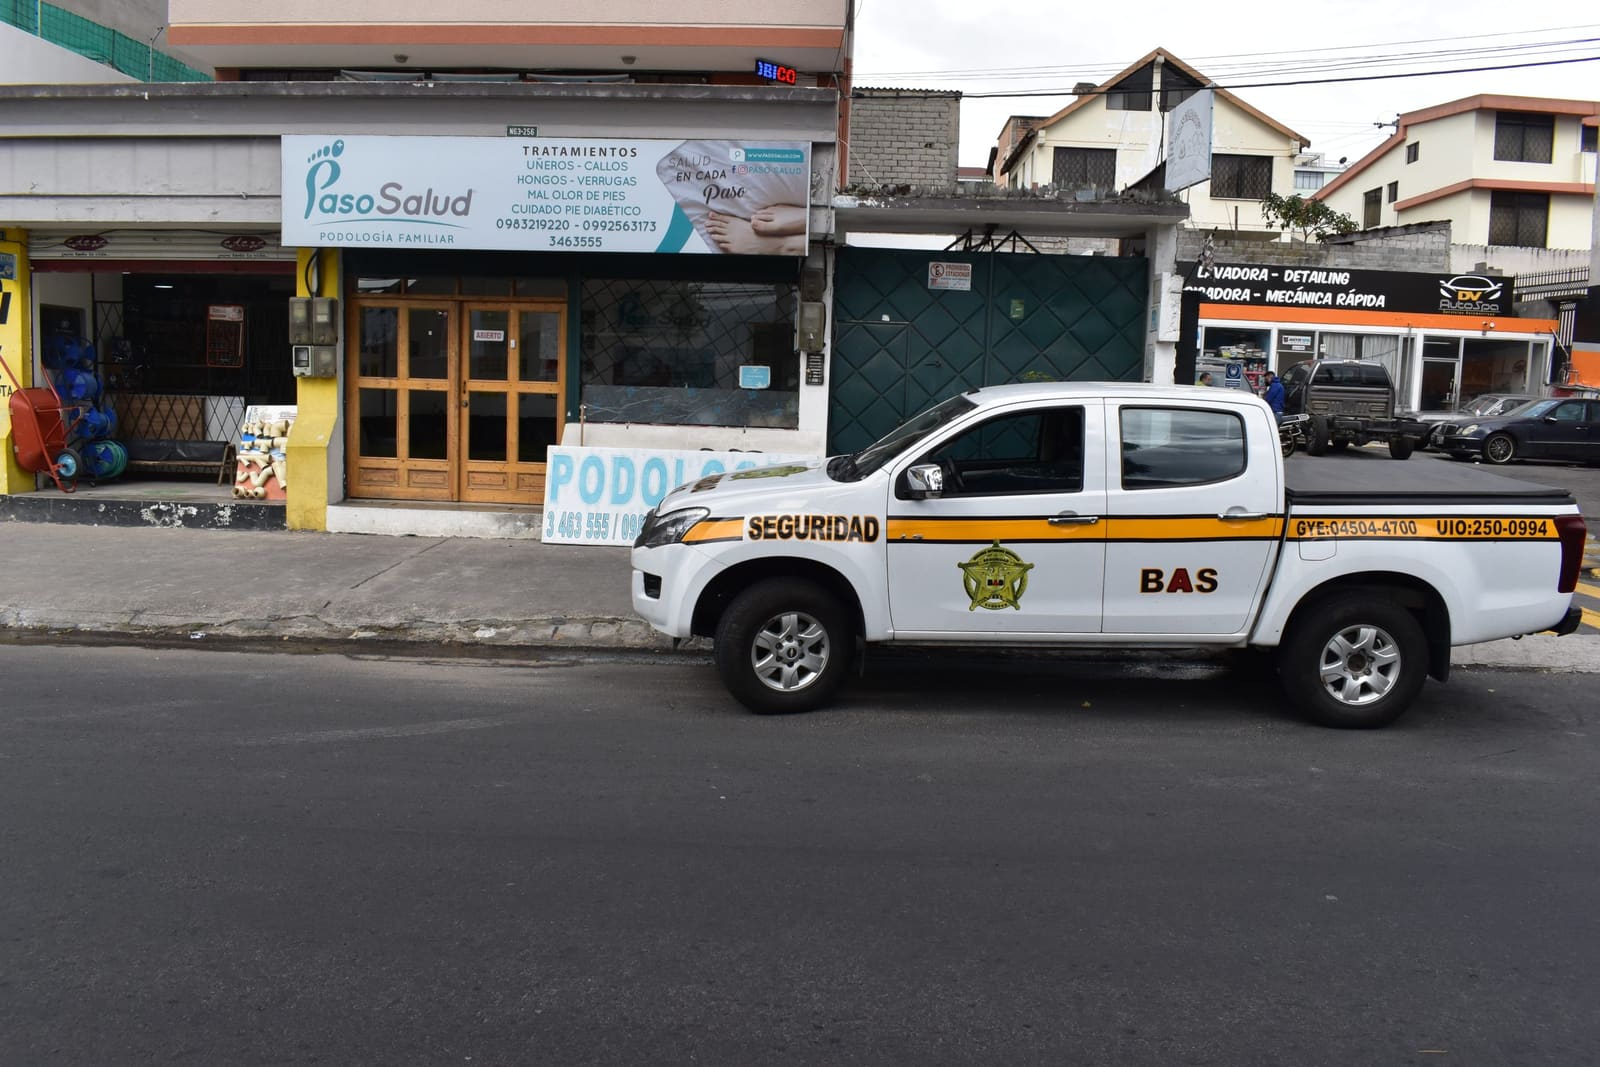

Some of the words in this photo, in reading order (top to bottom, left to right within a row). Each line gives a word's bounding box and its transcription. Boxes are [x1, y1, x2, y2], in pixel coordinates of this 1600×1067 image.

[523, 145, 638, 158] TRATAMIENTOS
[526, 157, 575, 171] UÑEROS
[584, 161, 629, 172] CALLOS
[668, 155, 711, 169] SALUD
[517, 175, 568, 186] HONGOS
[577, 176, 637, 187] VERRUGAS
[676, 172, 691, 182] EN
[695, 169, 727, 181] CADA
[527, 190, 550, 200] MAL
[552, 190, 584, 200] OLOR
[586, 191, 600, 201] DE
[602, 191, 626, 201] PIES
[703, 183, 746, 204] Paso
[511, 204, 562, 216] CUIDADO
[565, 205, 581, 216] PIE
[583, 203, 642, 217] DIABÉTICO
[496, 218, 570, 232] 0983219220
[582, 220, 657, 232] 0992563173
[399, 233, 455, 244] FAMILIAR
[549, 236, 603, 247] 3463555
[1284, 270, 1350, 285] DETAILING
[1266, 287, 1332, 306] MECÁNICA
[1336, 289, 1385, 308] RÁPIDA
[1457, 290, 1482, 301] DV
[546, 511, 555, 538] 3
[558, 511, 582, 539] 463
[586, 512, 610, 540] 555
[749, 515, 879, 542] SEGURIDAD
[1437, 519, 1548, 538] UIO:250-0994
[1140, 567, 1219, 593] BAS
